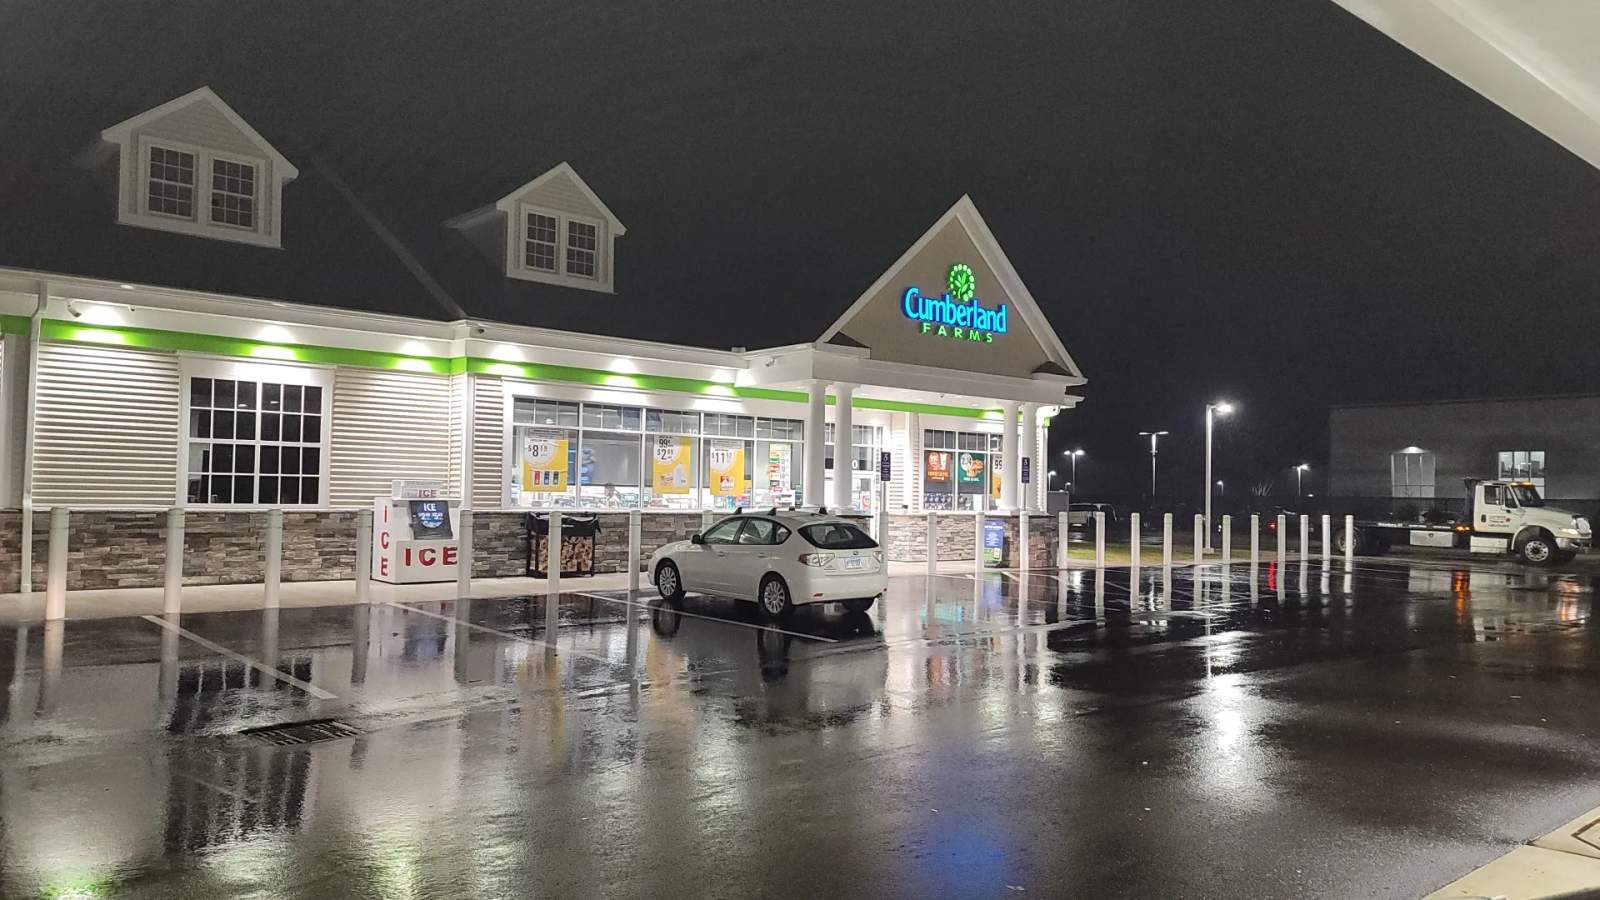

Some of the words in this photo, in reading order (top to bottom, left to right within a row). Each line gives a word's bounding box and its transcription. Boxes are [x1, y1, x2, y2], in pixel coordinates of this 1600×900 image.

[903, 287, 1008, 334] Cumberland
[922, 322, 993, 343] FARMS
[418, 489, 437, 498] ICE
[423, 502, 437, 512] ICE
[404, 546, 459, 567] ICE
